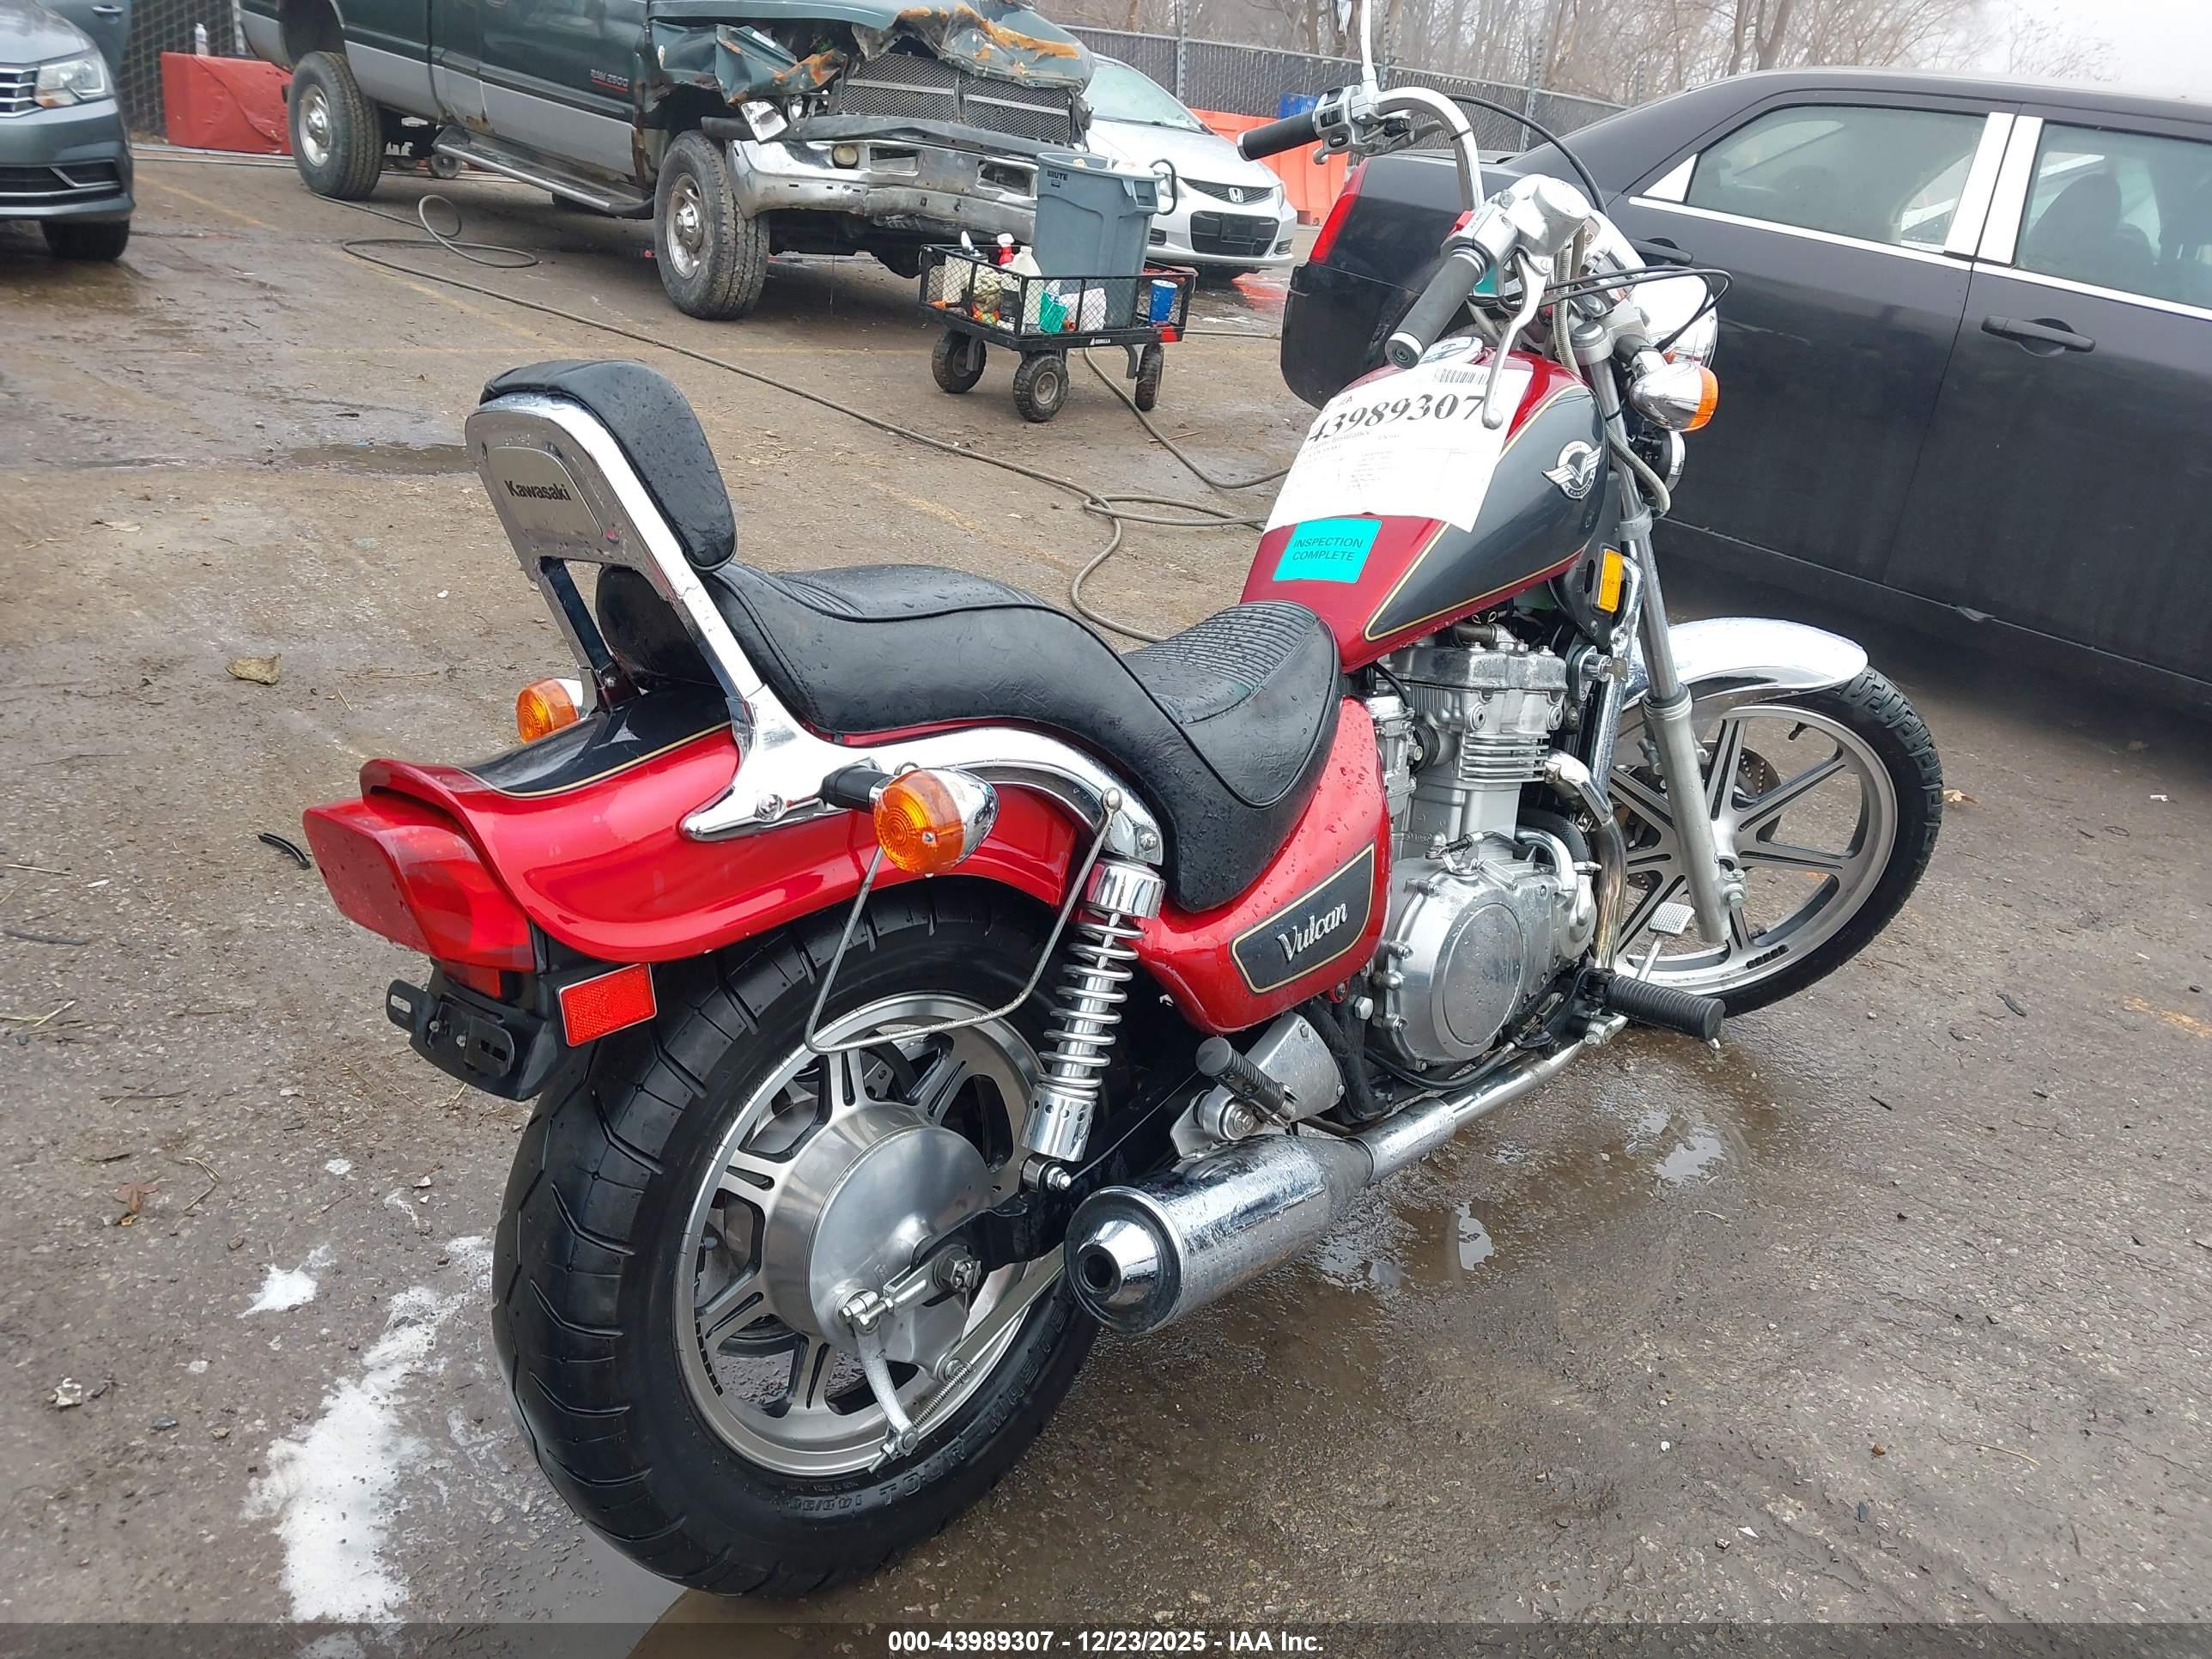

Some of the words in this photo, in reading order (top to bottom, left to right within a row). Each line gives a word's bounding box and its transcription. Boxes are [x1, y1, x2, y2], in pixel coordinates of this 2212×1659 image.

[607, 74, 629, 87] 2500
[1047, 169, 1068, 180] BRUTE
[1308, 394, 1486, 442] 43989307
[503, 479, 572, 501] Kawasaki
[1293, 537, 1364, 549] INSPECTION
[1292, 550, 1355, 562] COMPLETE
[1276, 902, 1348, 963] Vulcan
